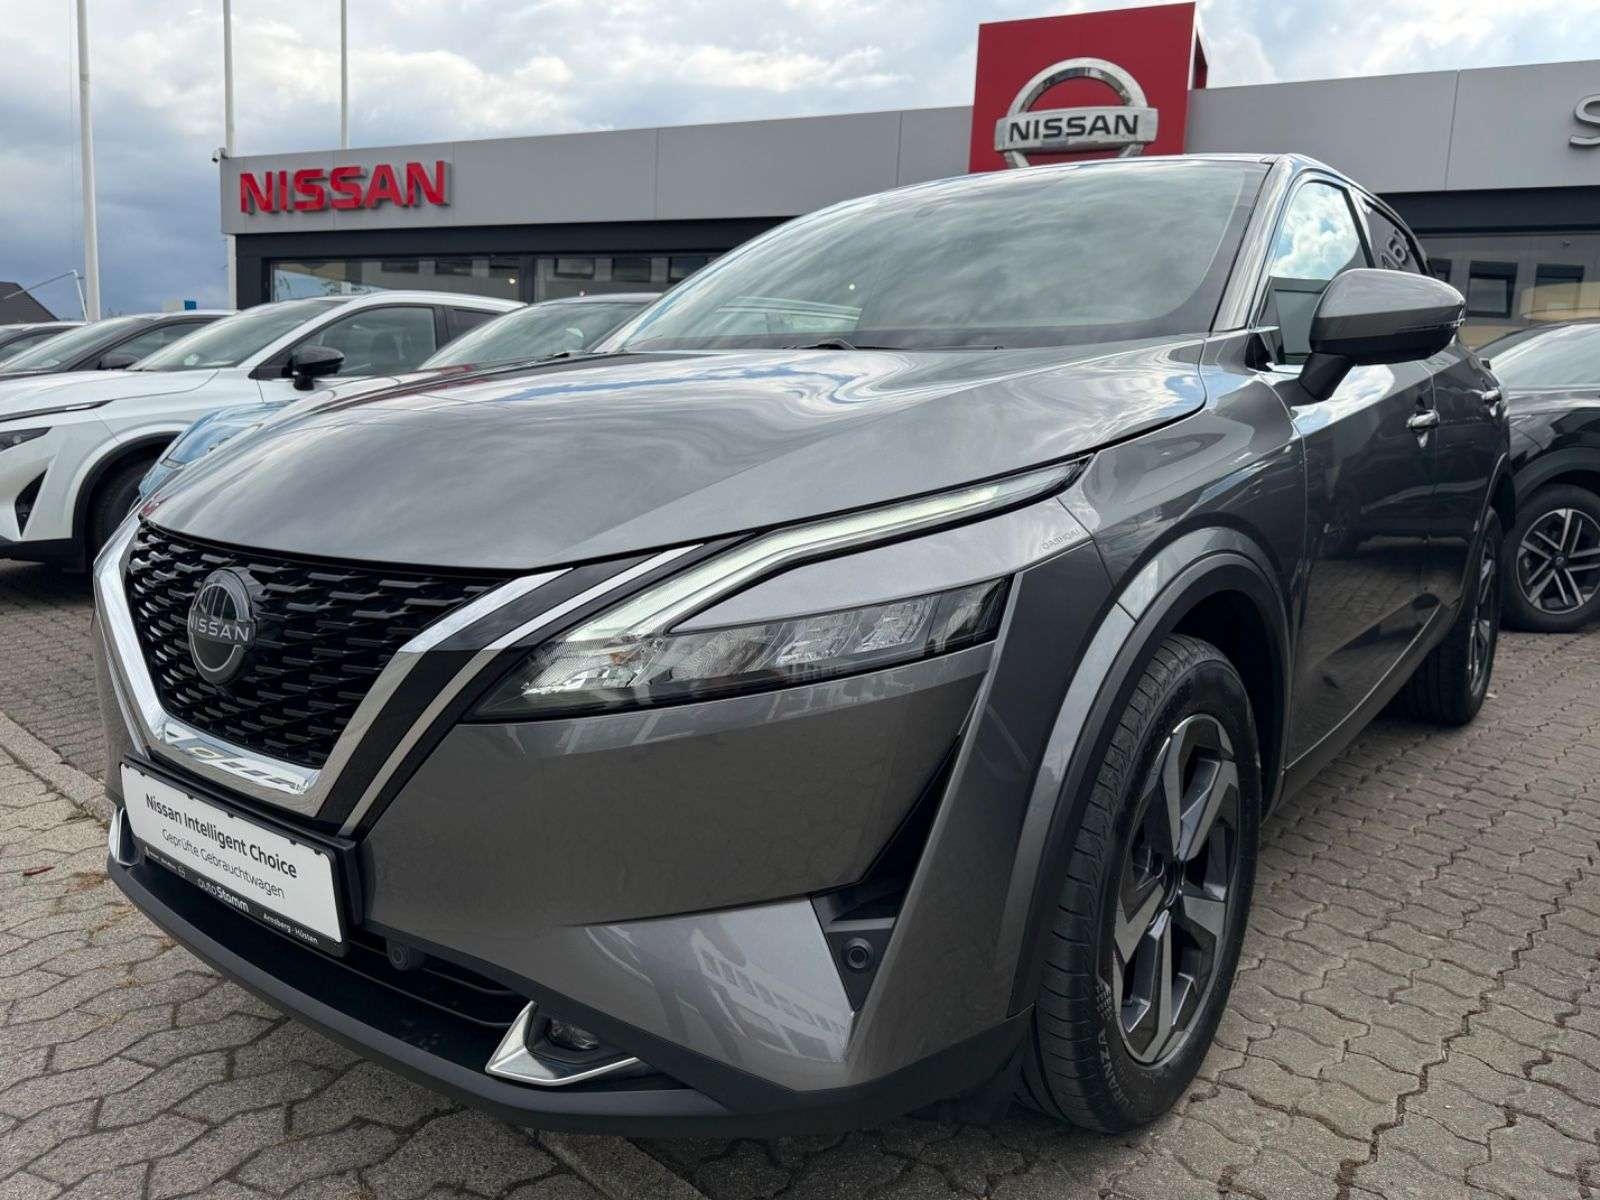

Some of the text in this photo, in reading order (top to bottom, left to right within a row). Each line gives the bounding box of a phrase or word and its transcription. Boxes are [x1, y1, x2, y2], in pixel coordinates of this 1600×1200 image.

[1009, 114, 1139, 142] NISSAN
[240, 160, 446, 214] NISSAN
[190, 614, 249, 642] NISSAN
[146, 793, 298, 878] Nissan Intelligent Choice
[162, 829, 199, 855] Geprüfte
[200, 848, 285, 898] Gebrauchtwagen
